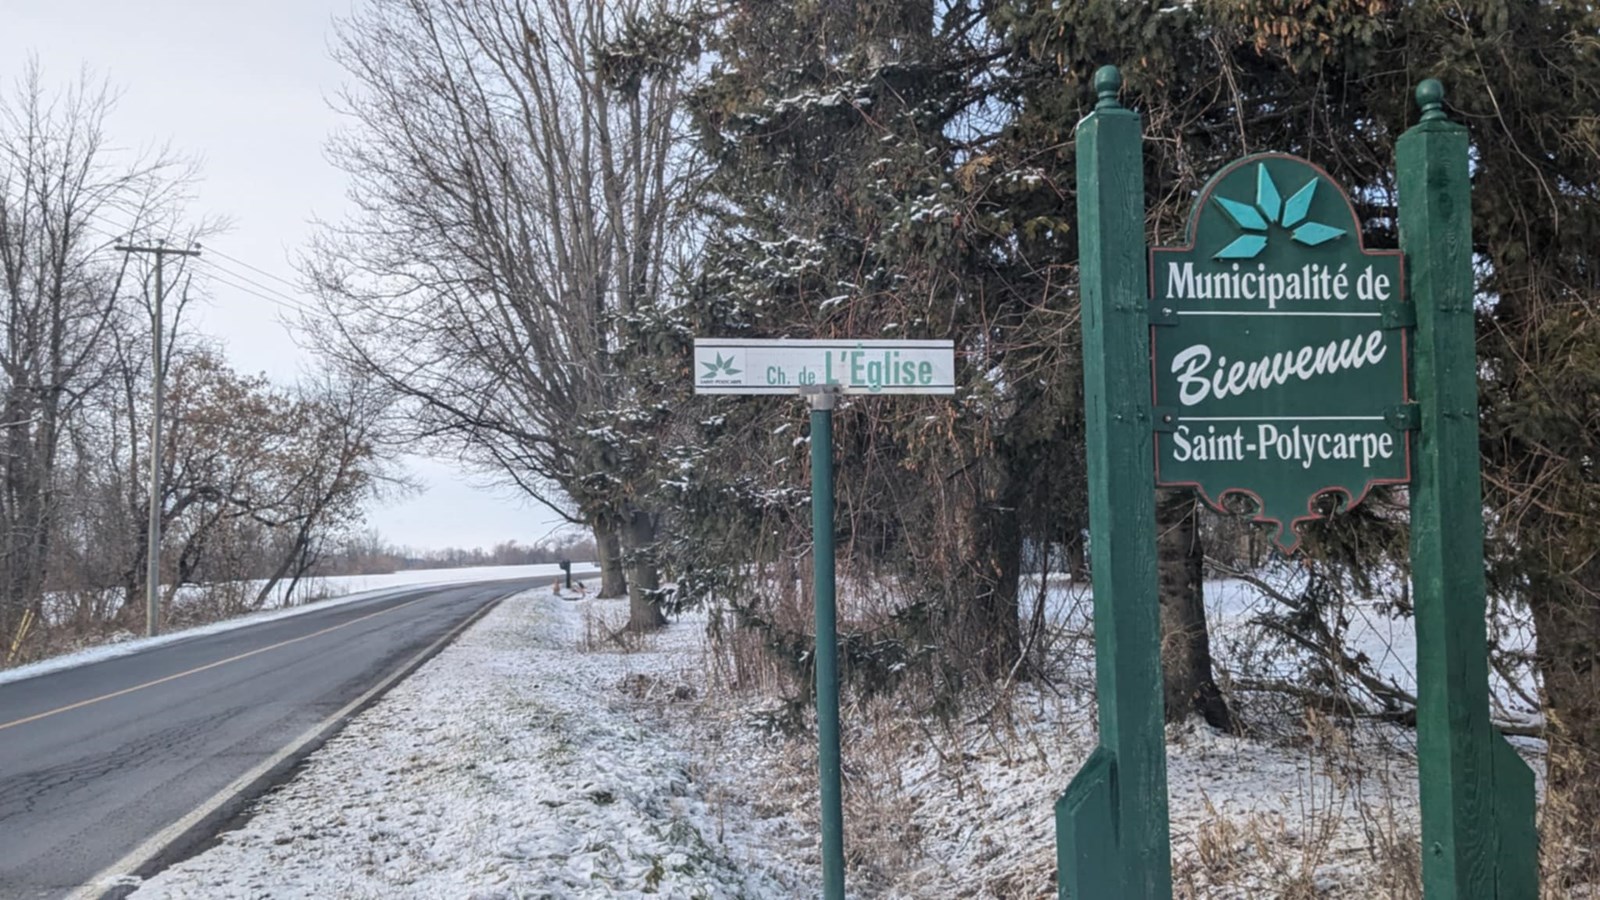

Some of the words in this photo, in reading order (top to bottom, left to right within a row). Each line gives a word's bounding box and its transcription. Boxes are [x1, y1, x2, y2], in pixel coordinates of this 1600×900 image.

[1166, 262, 1348, 308] Municipalité
[1356, 265, 1391, 300] de
[766, 366, 790, 385] Ch.
[799, 366, 816, 385] de
[825, 343, 932, 392] L'Église
[1171, 330, 1387, 406] Bienvenue
[1173, 424, 1393, 468] Saint-Polycarpe
